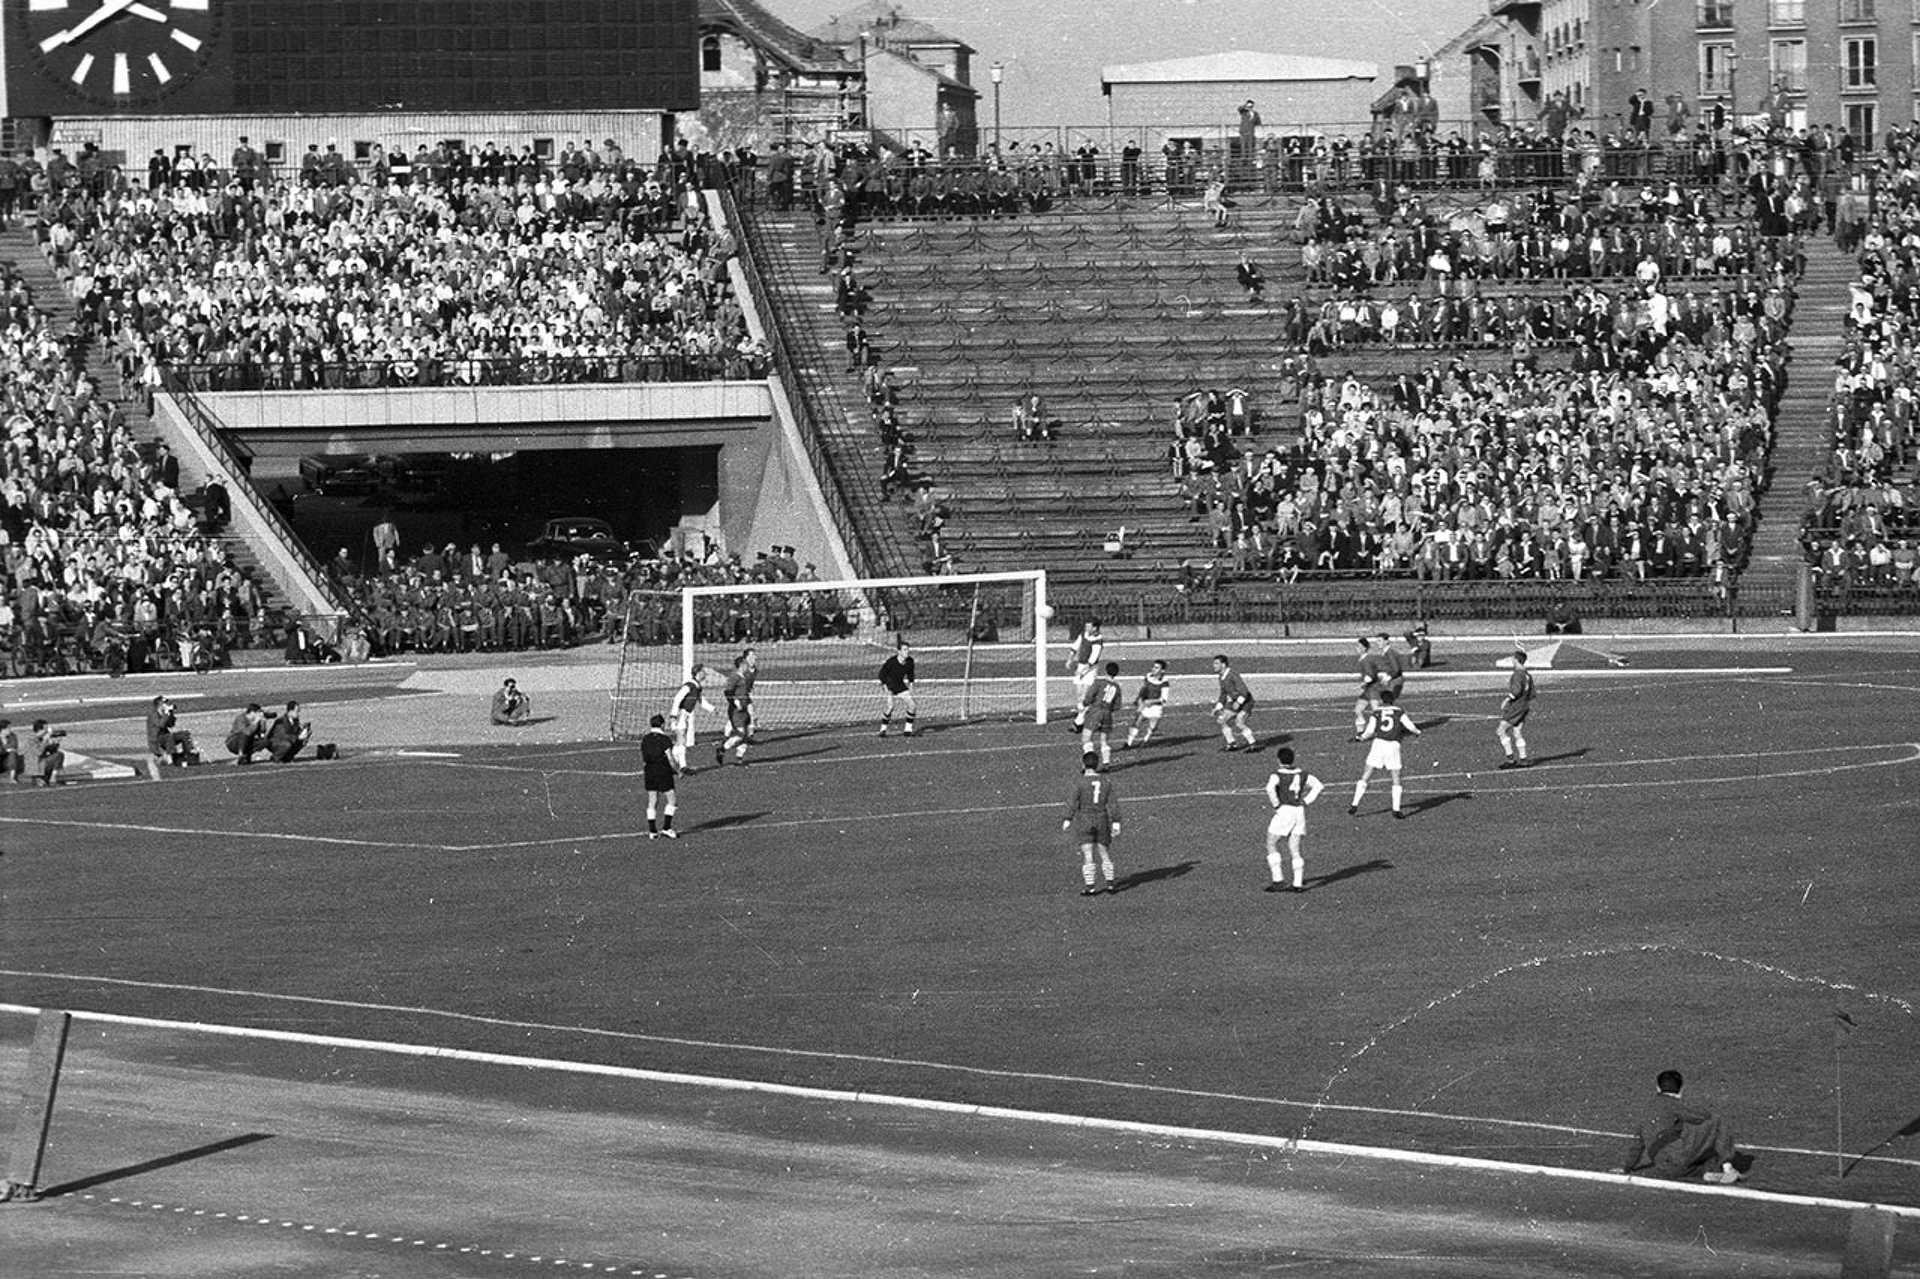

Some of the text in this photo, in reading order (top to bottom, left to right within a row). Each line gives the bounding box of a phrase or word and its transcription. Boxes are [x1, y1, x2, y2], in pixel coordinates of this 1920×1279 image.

[1380, 709, 1394, 732] 5
[1091, 780, 1102, 804] 7
[1288, 773, 1301, 800] 4
